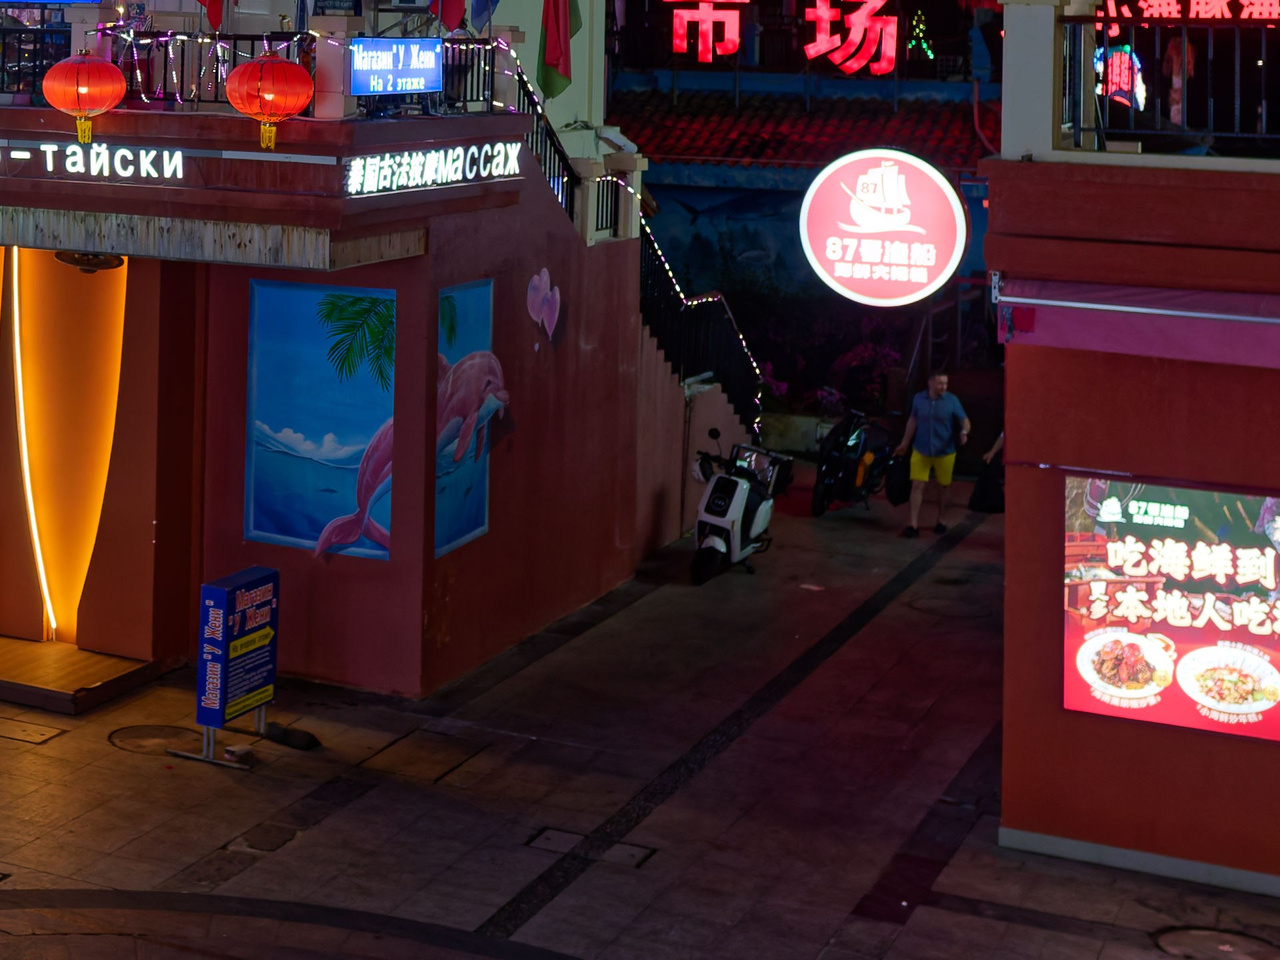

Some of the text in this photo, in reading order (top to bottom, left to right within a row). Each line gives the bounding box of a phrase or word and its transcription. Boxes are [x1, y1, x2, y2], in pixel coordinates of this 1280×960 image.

[370, 75, 425, 92] На 2 этаже
[861, 182, 878, 194] 87
[1106, 535, 1277, 590] 吃海鲜到
[201, 662, 222, 709] Магазин
